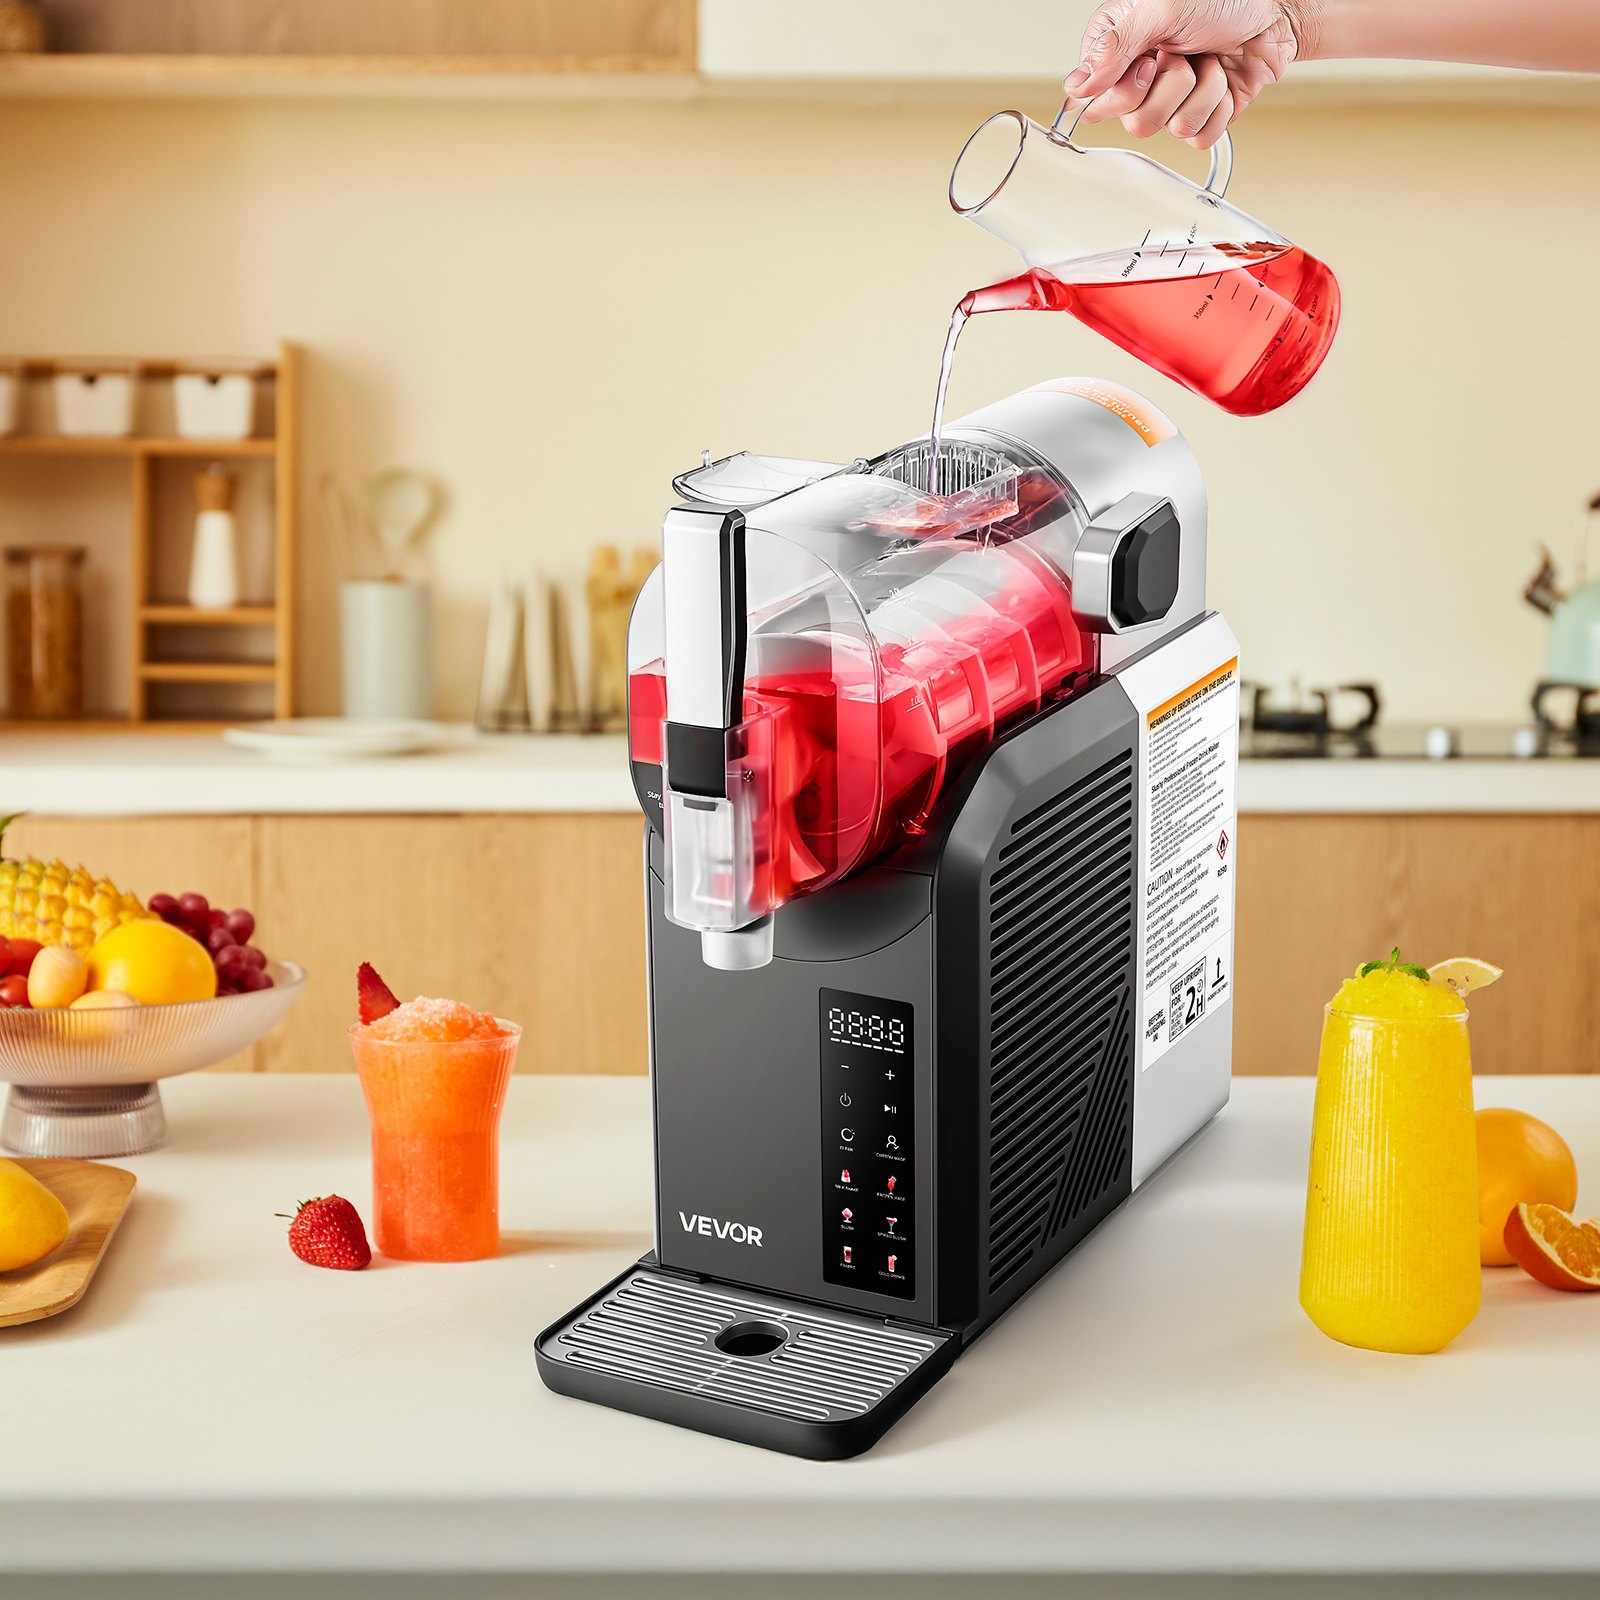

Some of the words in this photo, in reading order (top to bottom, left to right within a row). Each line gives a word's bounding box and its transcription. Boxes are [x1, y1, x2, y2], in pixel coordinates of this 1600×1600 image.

[1121, 258, 1137, 278] 550ml
[1193, 300, 1209, 320] 350ml
[1310, 294, 1319, 313] 100ml
[1263, 343, 1279, 362] 150ml
[1111, 407, 1127, 419] USE
[1111, 401, 1151, 433] turned
[1149, 710, 1171, 731] MEANINGS
[1171, 706, 1177, 716] OF
[1177, 697, 1191, 712] ERROR
[1191, 690, 1202, 703] CODE
[1202, 686, 1208, 696] ON
[1216, 670, 1232, 687] DISPLAY
[1151, 781, 1163, 794] Slushy
[1164, 764, 1186, 784] Professional
[1186, 757, 1198, 769] Frozen
[1198, 749, 1208, 761] Drink
[1208, 742, 1220, 754] Maker
[647, 790, 662, 801] Stay
[1147, 868, 1173, 896] CAUTION
[1183, 861, 1187, 869] of
[1165, 876, 1184, 894] refrigerator
[1172, 980, 1183, 996] KEEP
[1184, 963, 1204, 986] UPRIGHT
[1171, 994, 1181, 1008] FOR
[1185, 986, 1196, 1025] 2
[1196, 994, 1203, 1016] H
[1146, 1016, 1166, 1039] PLUGGING
[1148, 1009, 1163, 1027] BEFORE
[1153, 1033, 1158, 1042] IN
[678, 1211, 762, 1248] VEVOR
